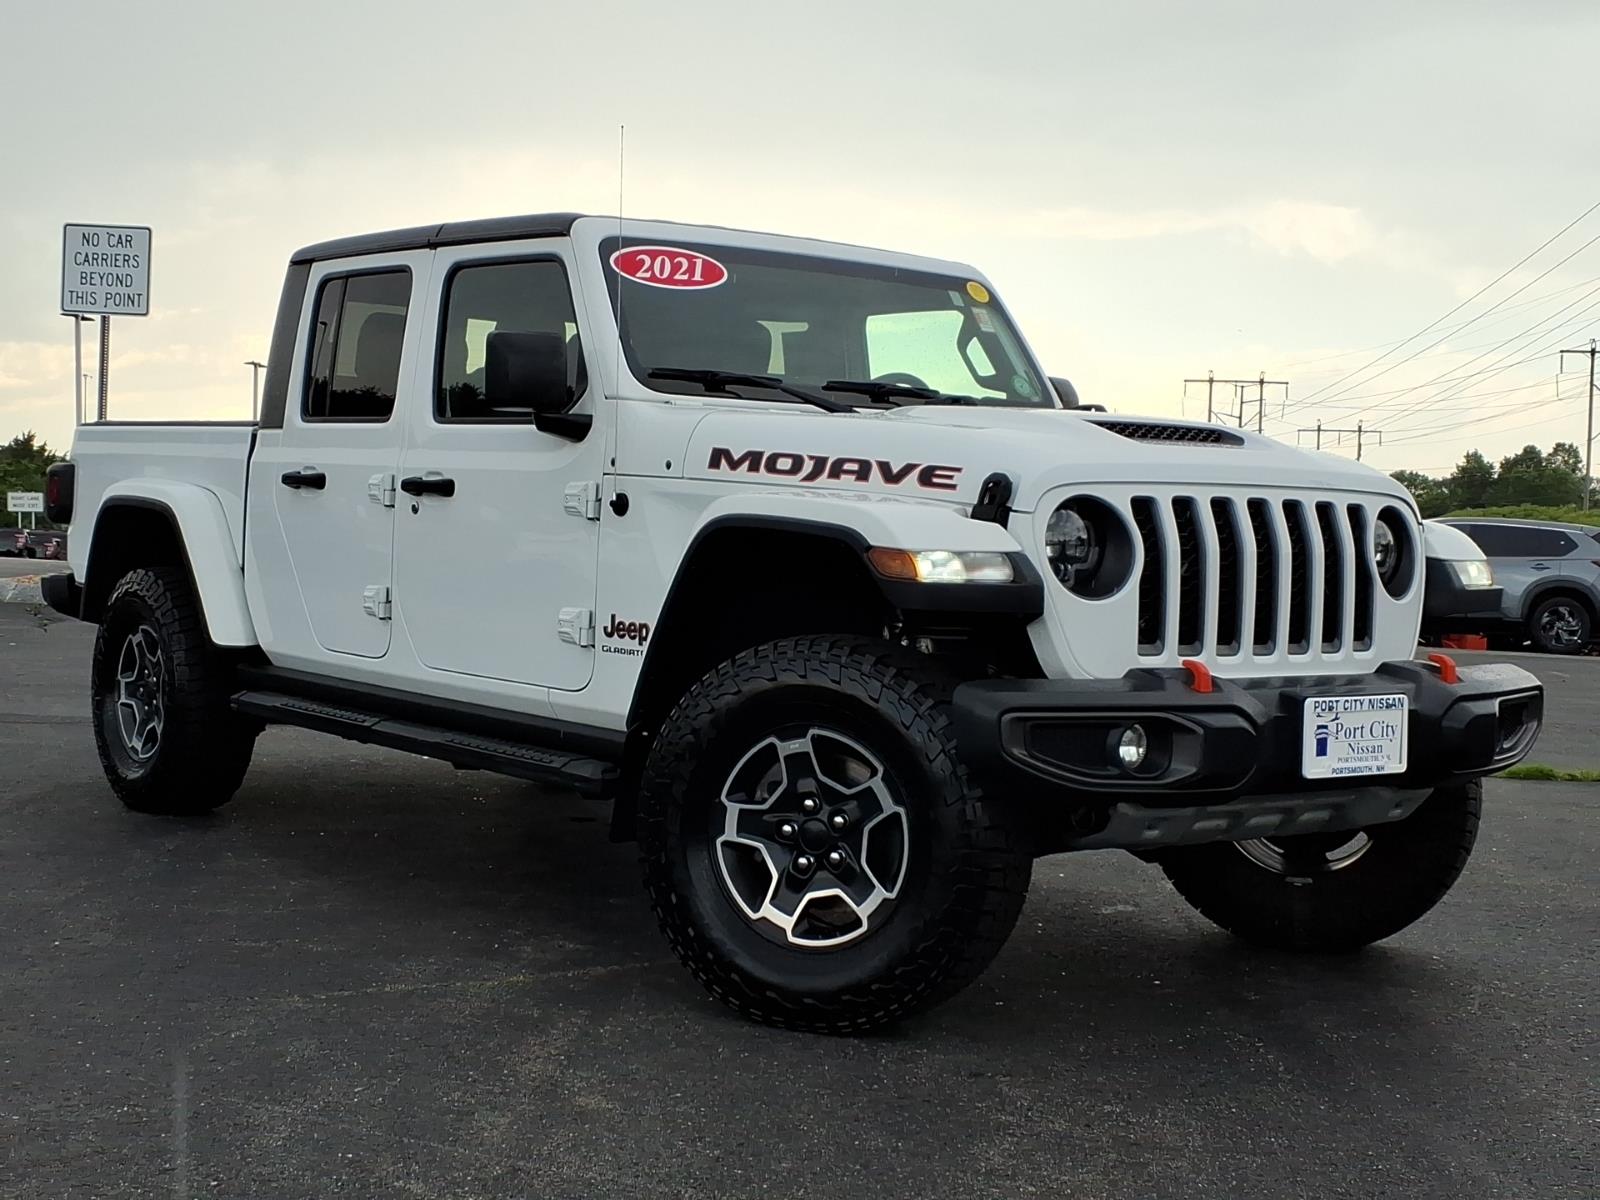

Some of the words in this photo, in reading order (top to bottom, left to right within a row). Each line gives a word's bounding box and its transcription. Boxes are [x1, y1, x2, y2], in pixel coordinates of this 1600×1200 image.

[81, 232, 100, 248] NO
[107, 233, 133, 249] CAR
[74, 251, 140, 269] CARRIERS
[635, 254, 704, 281] 2021
[80, 271, 133, 288] BEYOND
[68, 290, 97, 306] THIS
[104, 291, 143, 308] POINT
[707, 446, 963, 491] MOJAVE
[603, 613, 650, 646] Jeep
[1313, 699, 1340, 712] PORT
[1343, 699, 1365, 711] CITY
[1367, 697, 1405, 710] NISSAN
[1335, 722, 1366, 740] Port
[1369, 720, 1398, 742] City
[1347, 742, 1383, 755] Nissan
